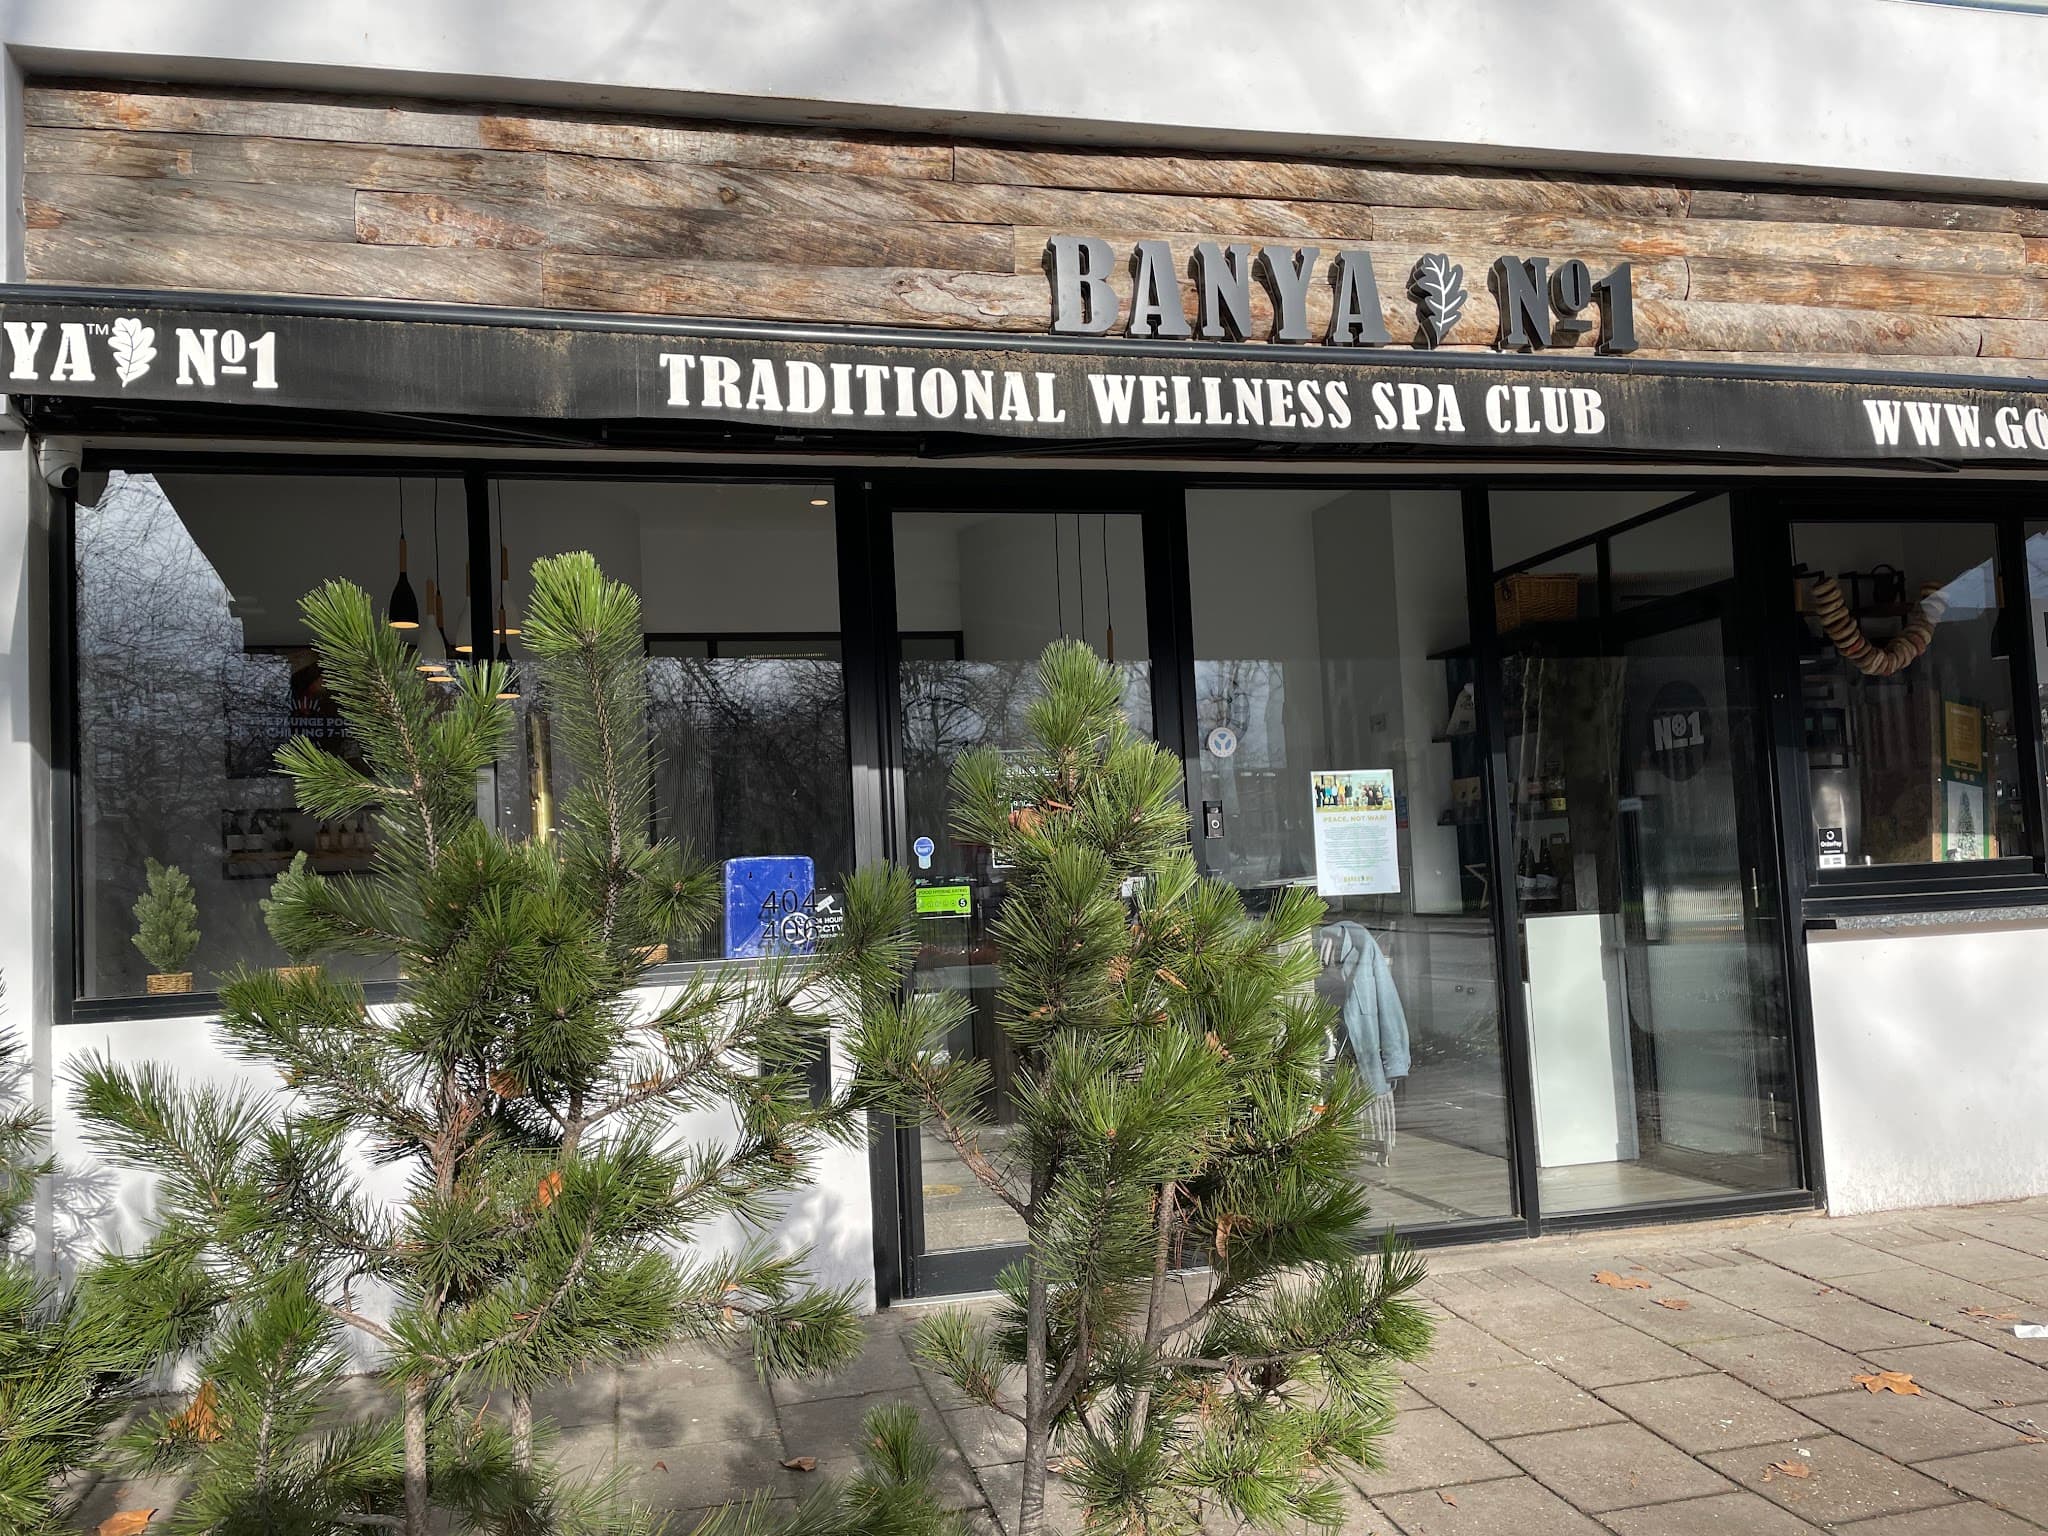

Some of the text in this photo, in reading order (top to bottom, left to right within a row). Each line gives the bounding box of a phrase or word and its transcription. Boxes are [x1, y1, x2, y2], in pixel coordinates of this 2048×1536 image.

[1042, 235, 1393, 347] BANYA
[659, 352, 1606, 435] TRADITIONAL WELLNESS SPA CLUB
[1863, 399, 2048, 451] WWW.GO
[762, 889, 819, 914] 404
[824, 916, 844, 924] HOUR
[762, 917, 819, 943] 406
